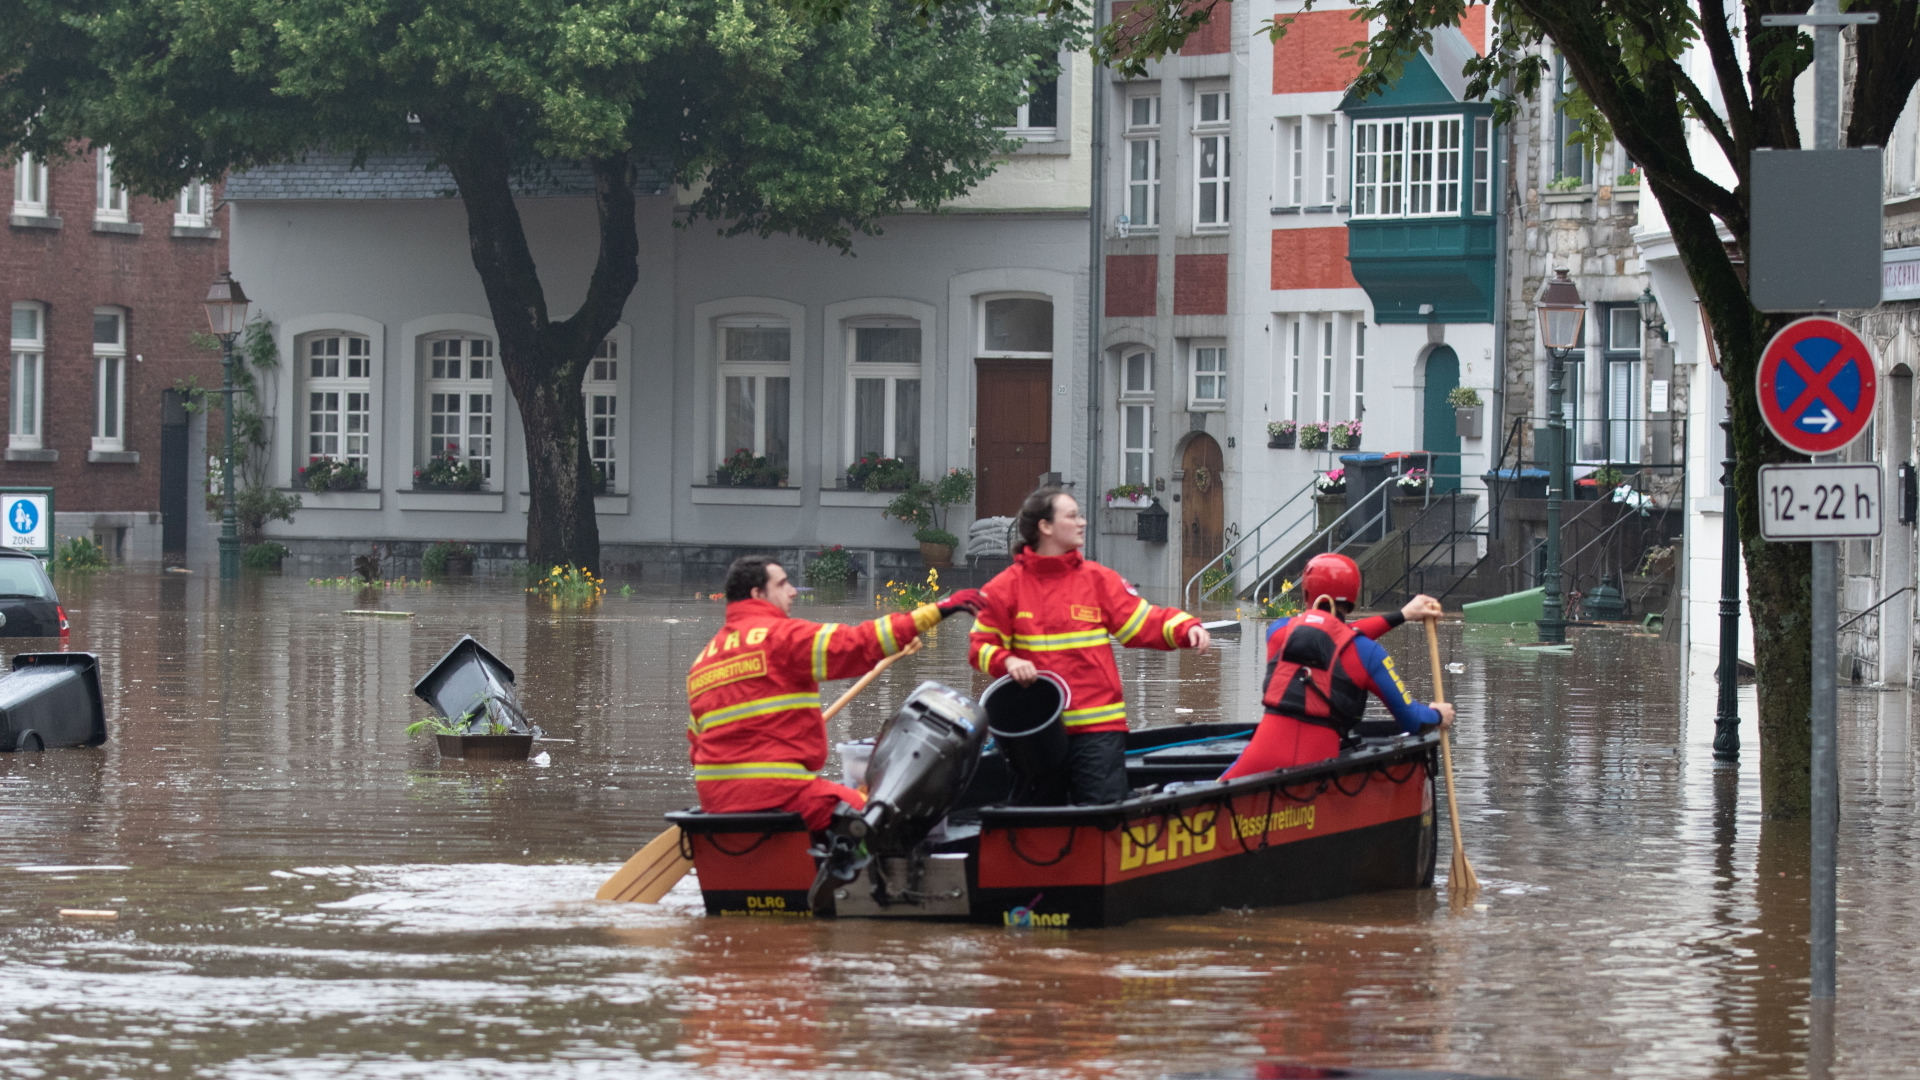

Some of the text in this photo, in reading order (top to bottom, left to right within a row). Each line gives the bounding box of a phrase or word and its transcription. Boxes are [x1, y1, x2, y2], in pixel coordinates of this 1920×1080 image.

[1855, 483, 1871, 519] h
[12, 536, 35, 545] ZONE
[1120, 810, 1216, 871] DLRG
[747, 896, 786, 908] DLRG
